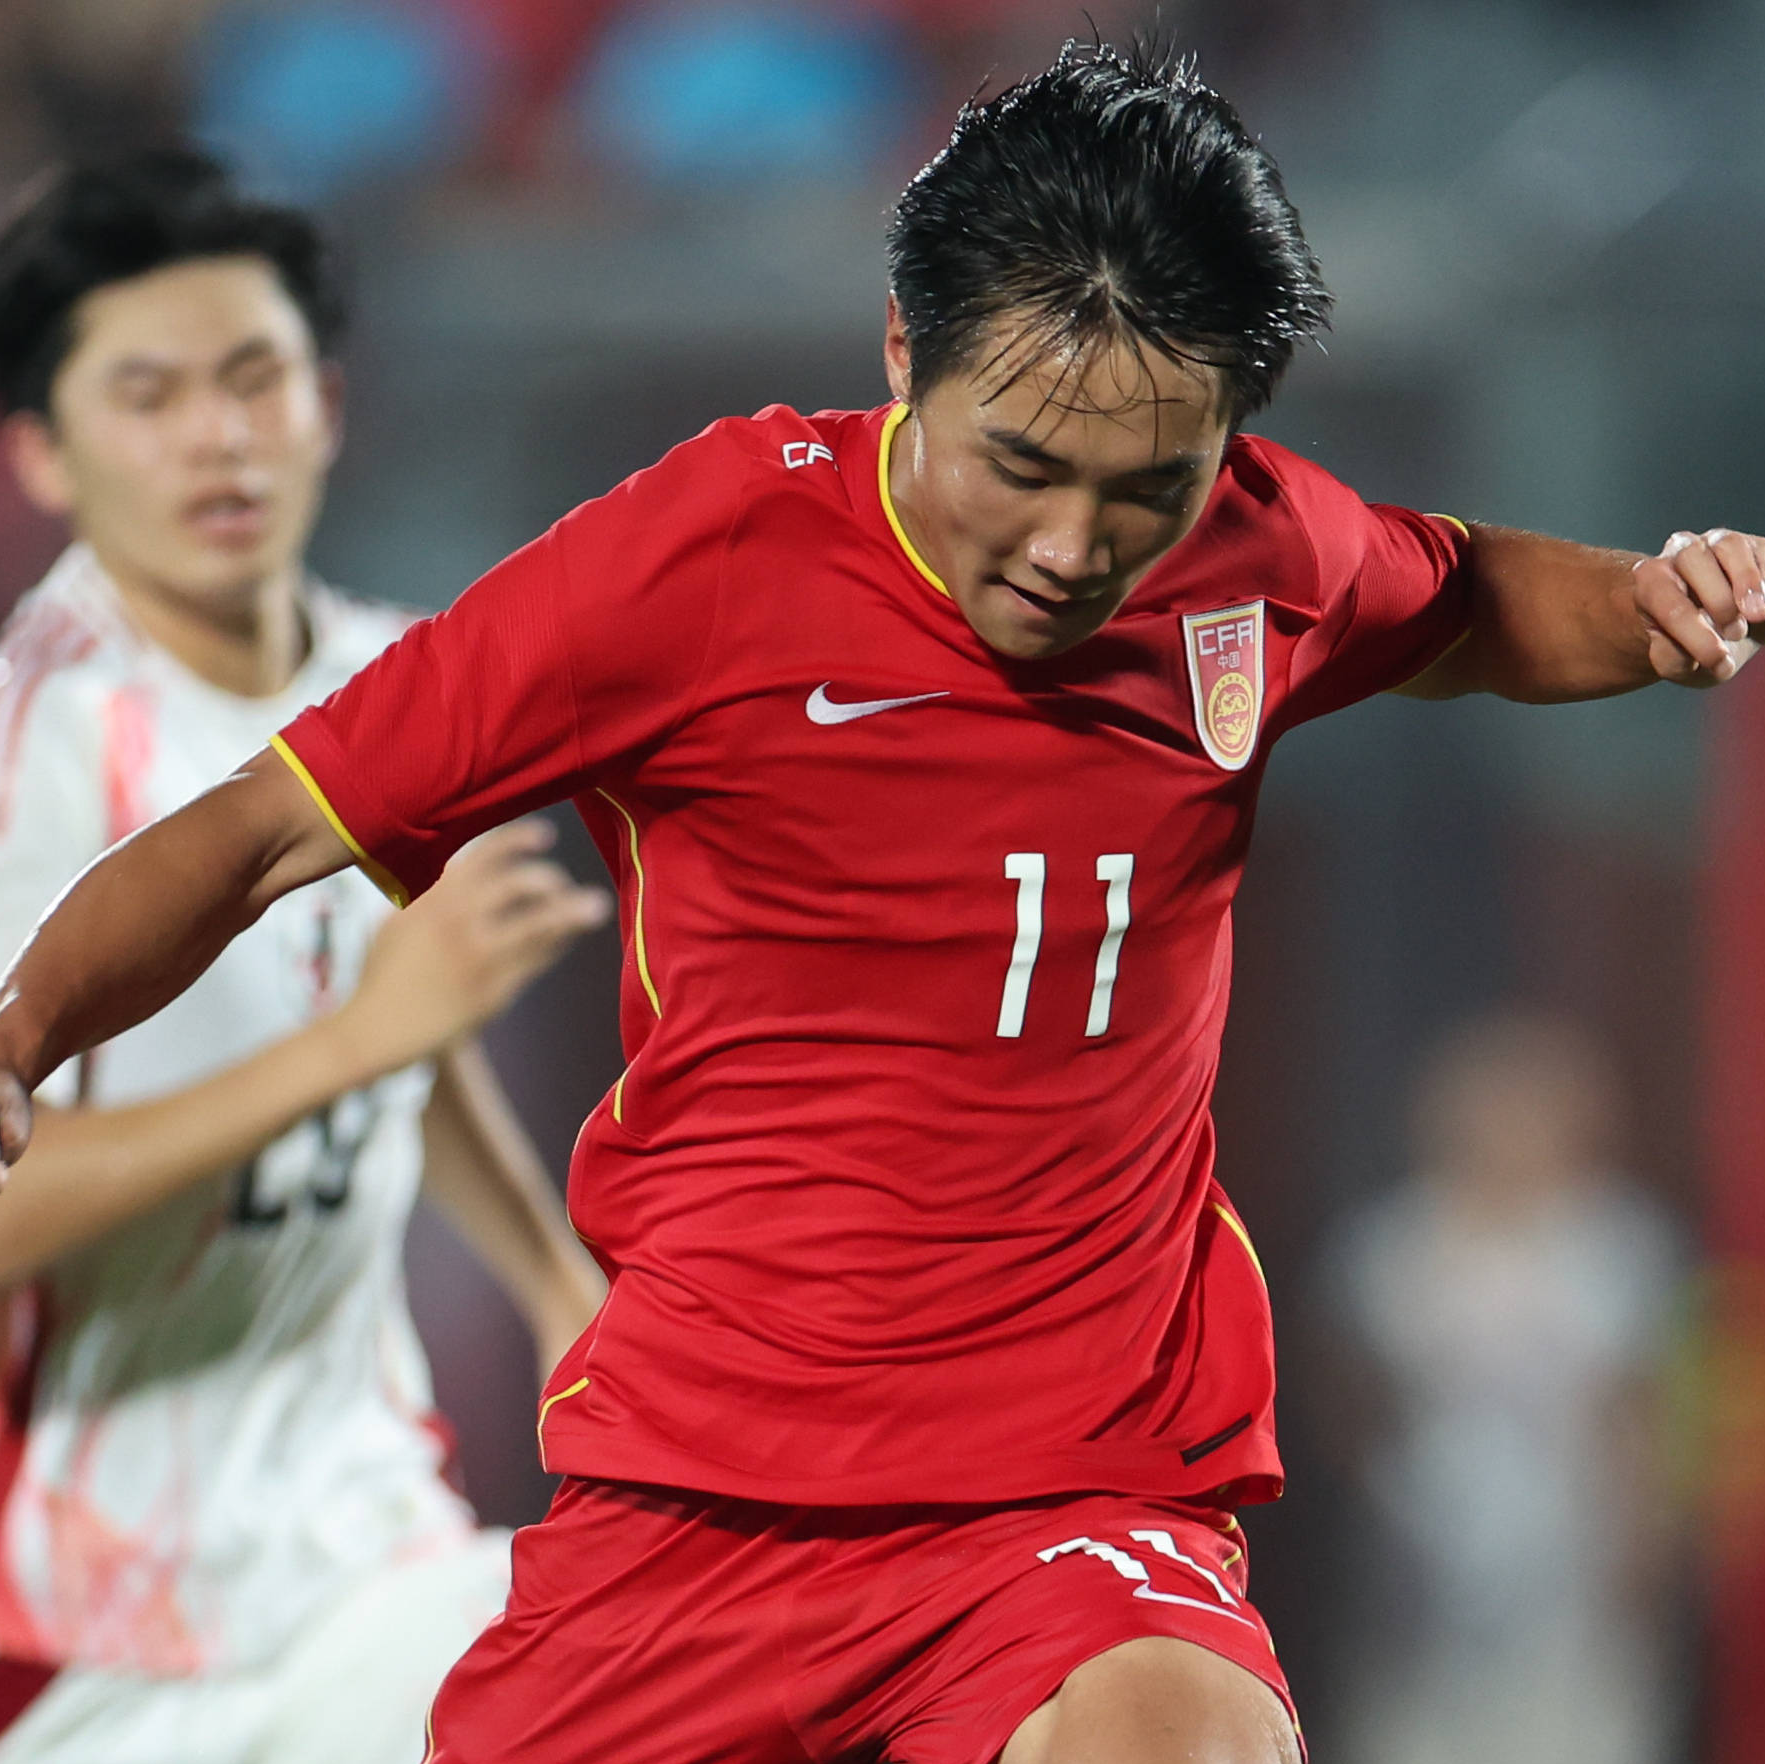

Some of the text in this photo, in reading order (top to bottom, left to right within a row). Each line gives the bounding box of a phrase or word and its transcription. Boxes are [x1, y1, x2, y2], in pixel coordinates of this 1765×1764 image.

[782, 441, 839, 472] CF
[1197, 619, 1254, 656] CFA
[995, 852, 1134, 1038] 11
